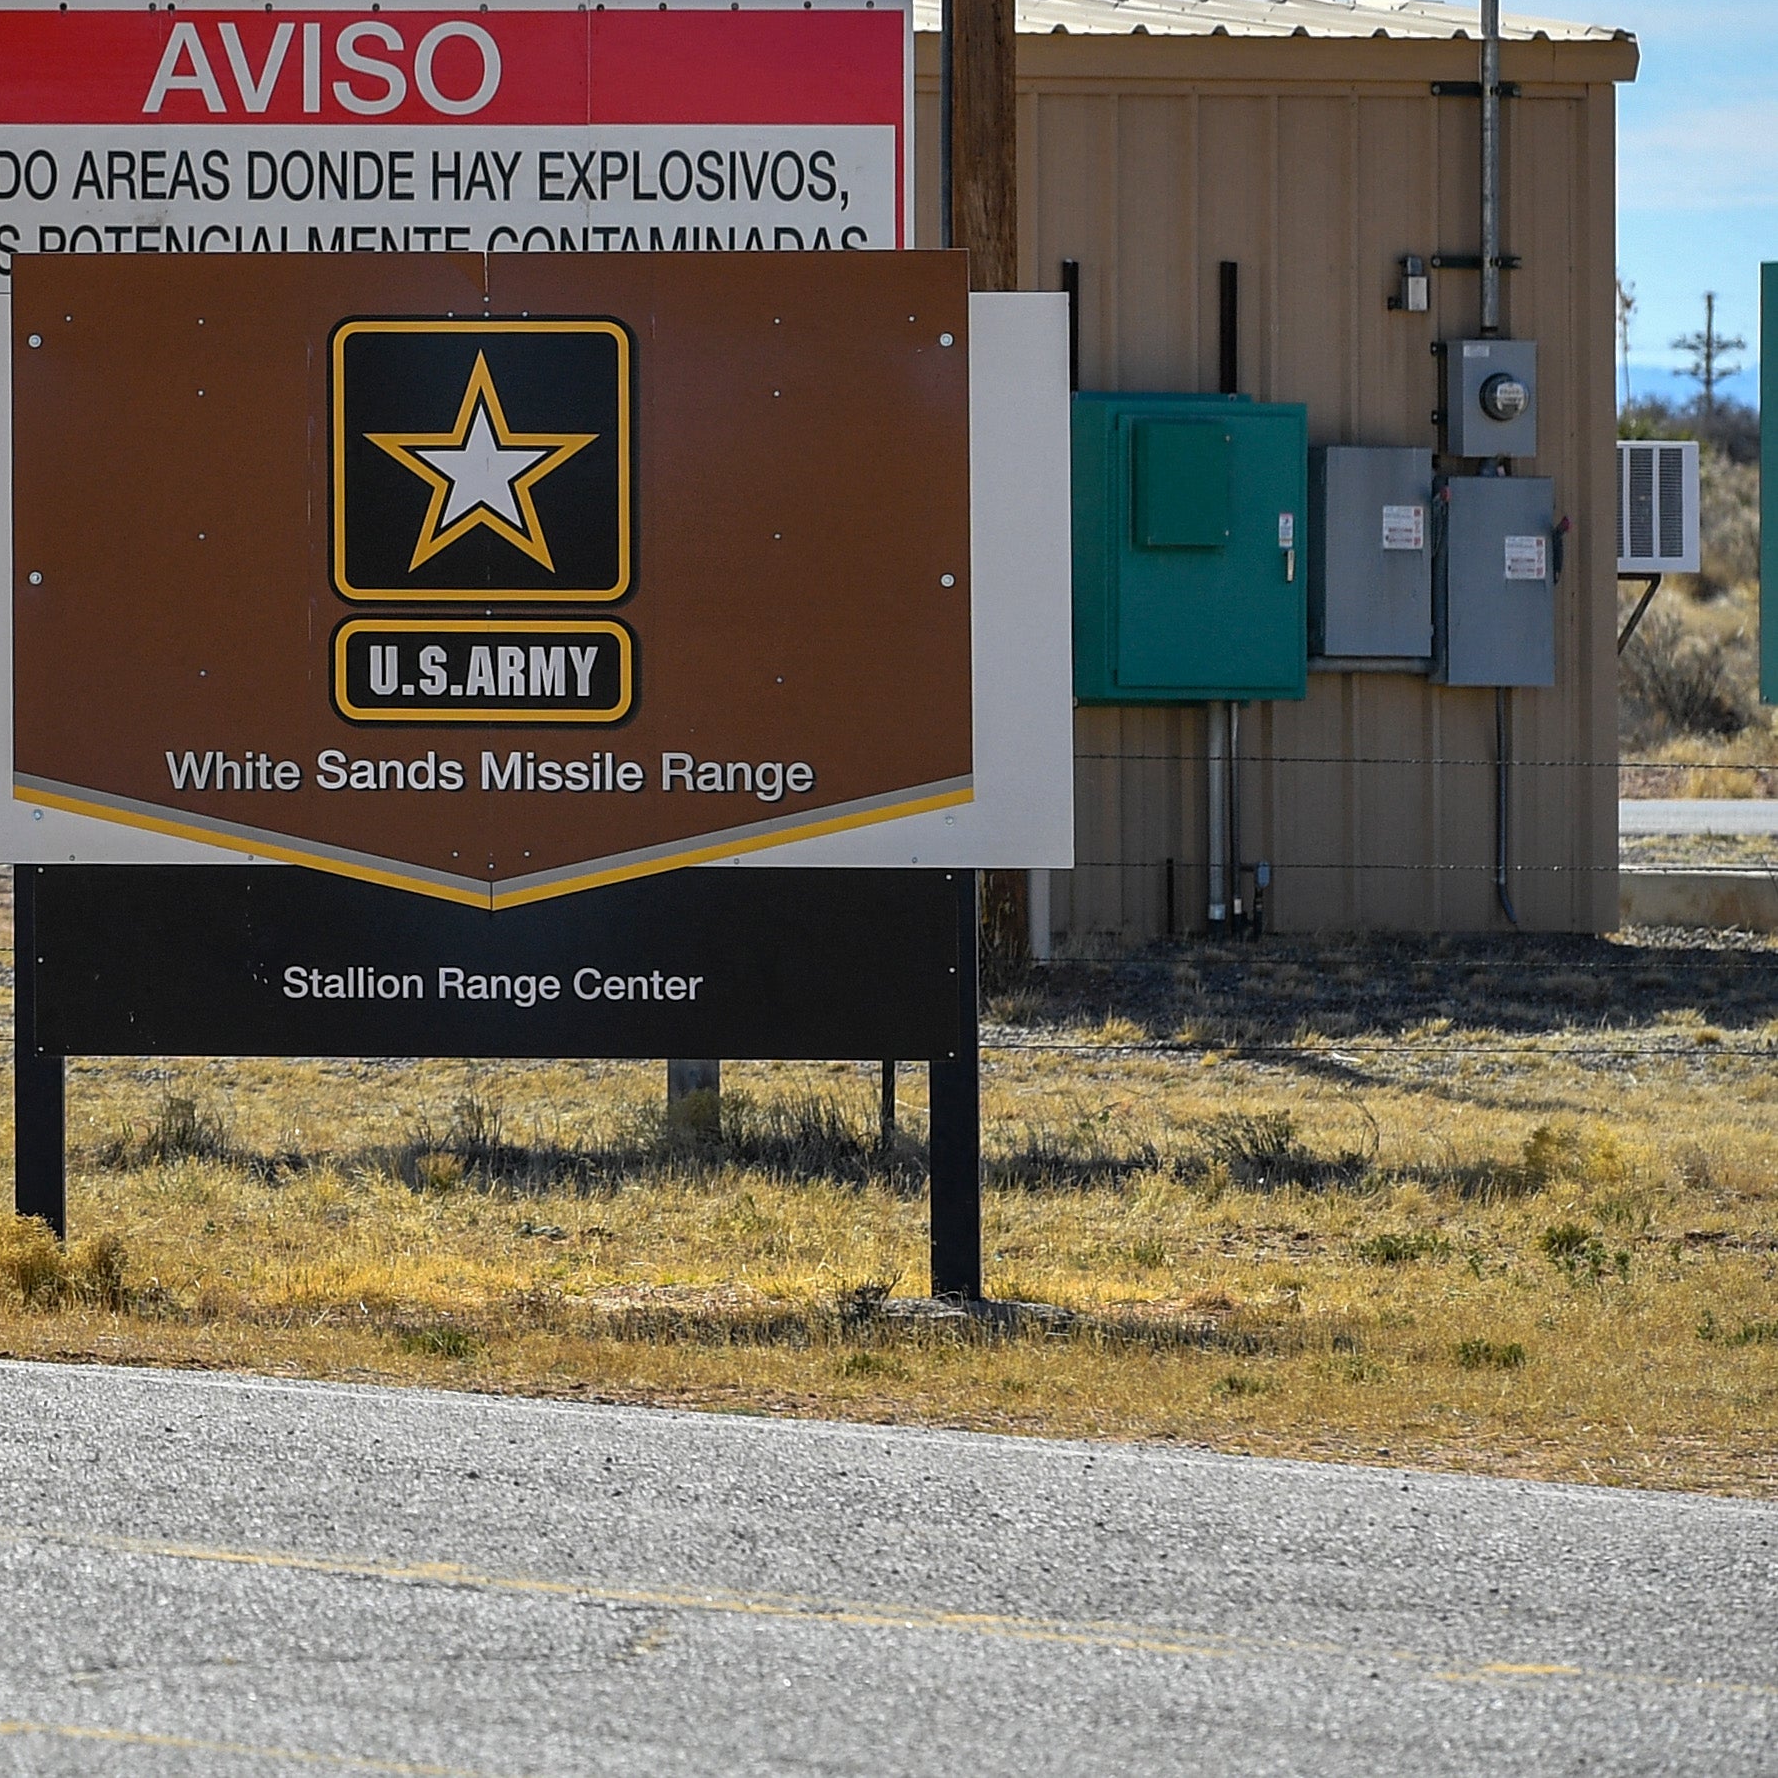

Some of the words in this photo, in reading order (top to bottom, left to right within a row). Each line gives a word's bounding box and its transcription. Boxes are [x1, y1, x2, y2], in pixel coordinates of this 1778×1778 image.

[141, 20, 502, 116] AVISO
[72, 149, 230, 201] AREAS
[247, 149, 415, 202] DONDE
[432, 150, 522, 201] HAY
[539, 149, 849, 208] EXPLOSIVOS,
[165, 751, 301, 790] White
[316, 749, 464, 790] Sands
[481, 751, 644, 792] Missile
[662, 752, 815, 803] Range
[283, 966, 424, 999] Stallion
[438, 967, 561, 1008] Range
[573, 967, 704, 1001] Center
